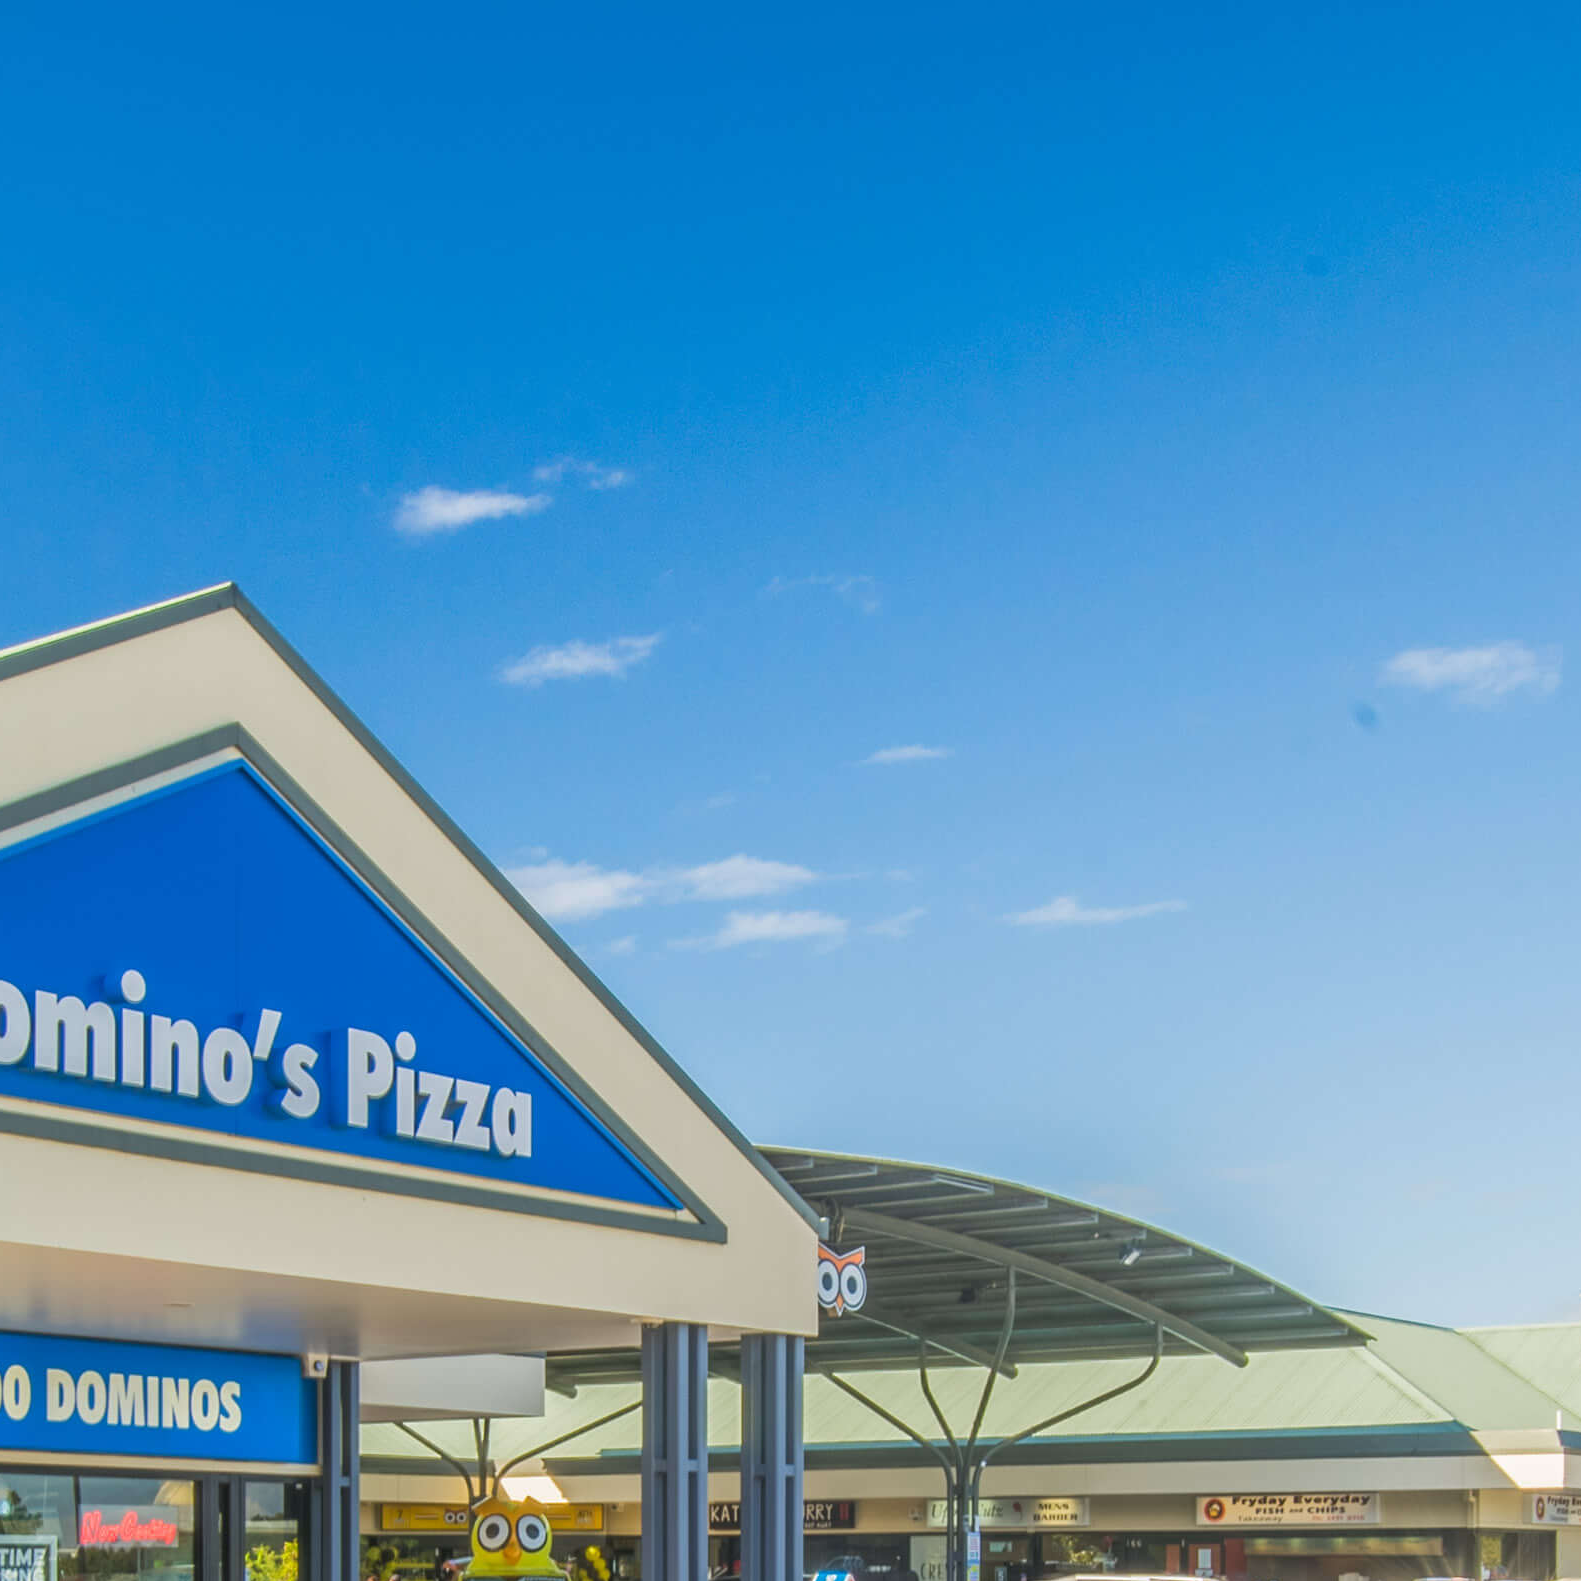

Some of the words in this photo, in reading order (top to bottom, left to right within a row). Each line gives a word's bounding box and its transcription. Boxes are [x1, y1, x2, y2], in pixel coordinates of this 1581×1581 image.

[345, 1028, 533, 1158] Pizza
[46, 1367, 243, 1433] DOMINOS
[1231, 1495, 1287, 1508] Fryday
[1292, 1494, 1371, 1506] Everyday
[1032, 1513, 1079, 1521] BARBER
[1255, 1506, 1284, 1515] FISH
[1307, 1506, 1346, 1514] CHIPS
